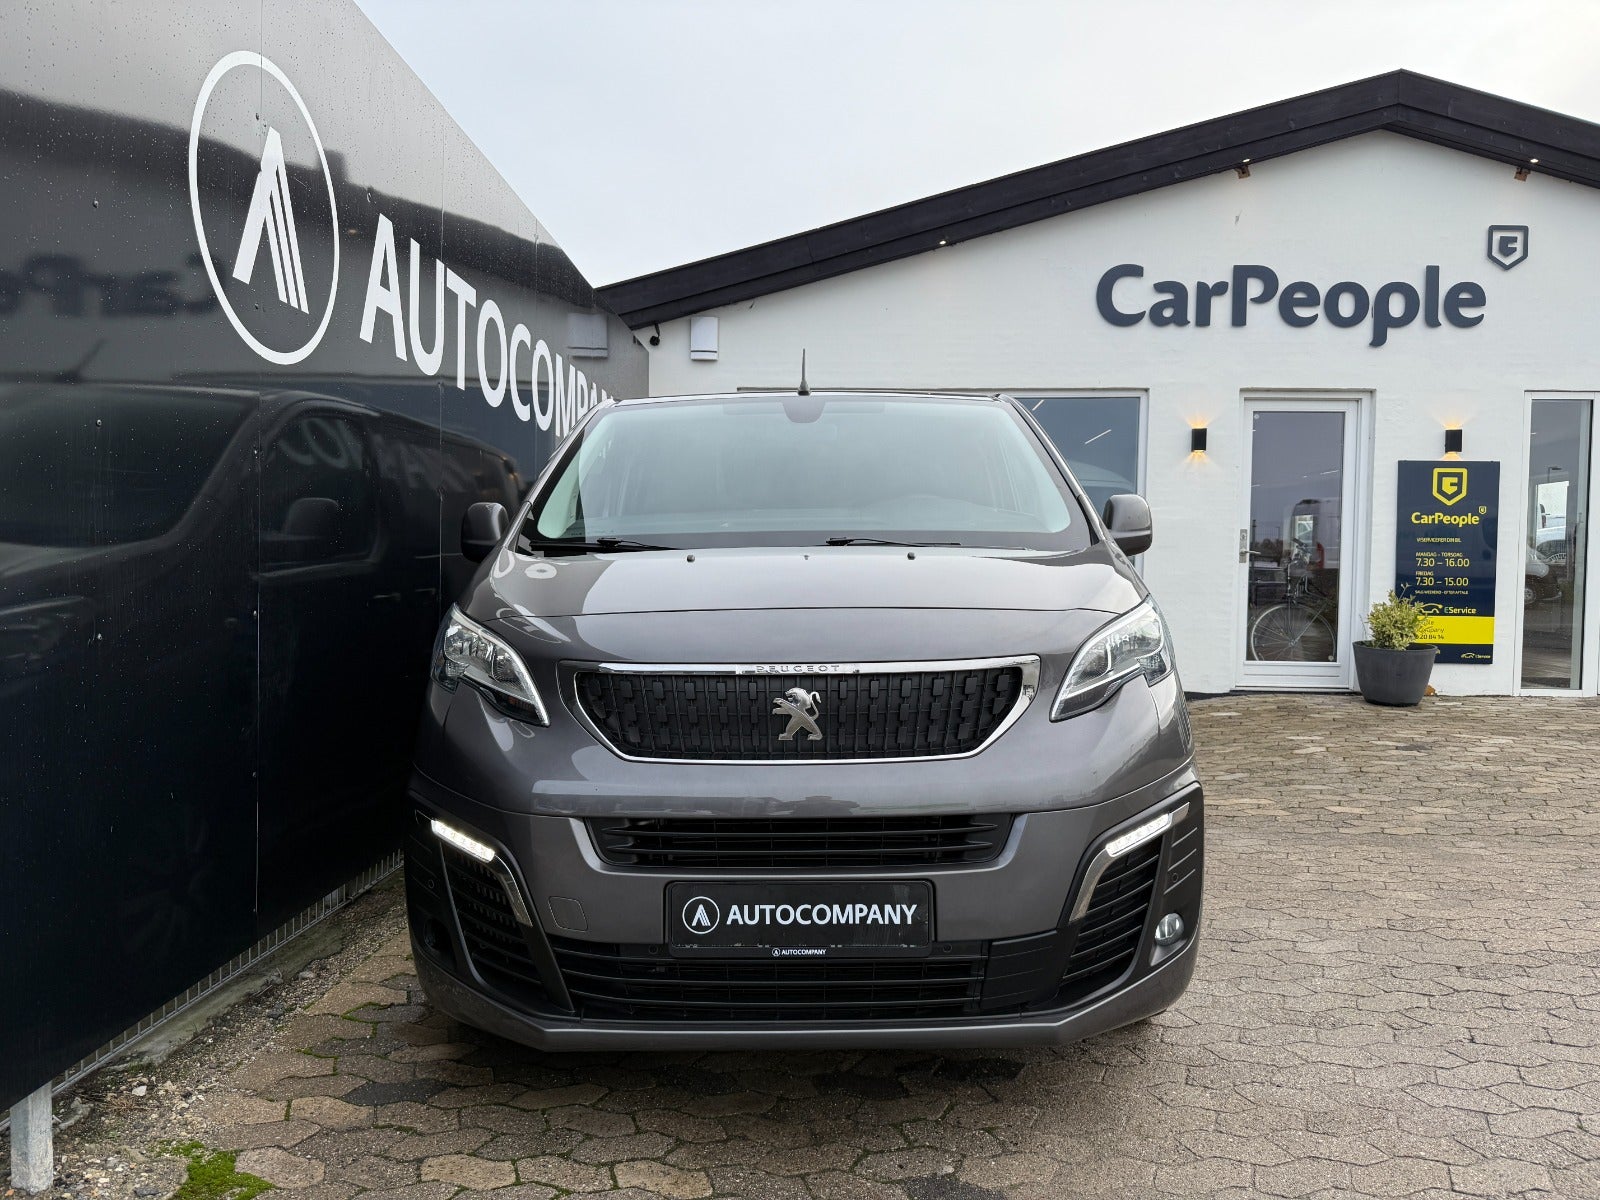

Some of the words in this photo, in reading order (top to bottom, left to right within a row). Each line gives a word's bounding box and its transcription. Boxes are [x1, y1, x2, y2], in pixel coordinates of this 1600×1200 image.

[1096, 263, 1487, 347] CarPeople
[1411, 512, 1479, 527] CarPeople
[1415, 558, 1435, 567] 7.30
[1445, 558, 1470, 567] 16.00
[1415, 577, 1435, 586] 7.30
[1444, 577, 1469, 586] 15.00
[755, 665, 840, 673] PEUGEOT
[726, 904, 917, 925] AUTOCOMPANY
